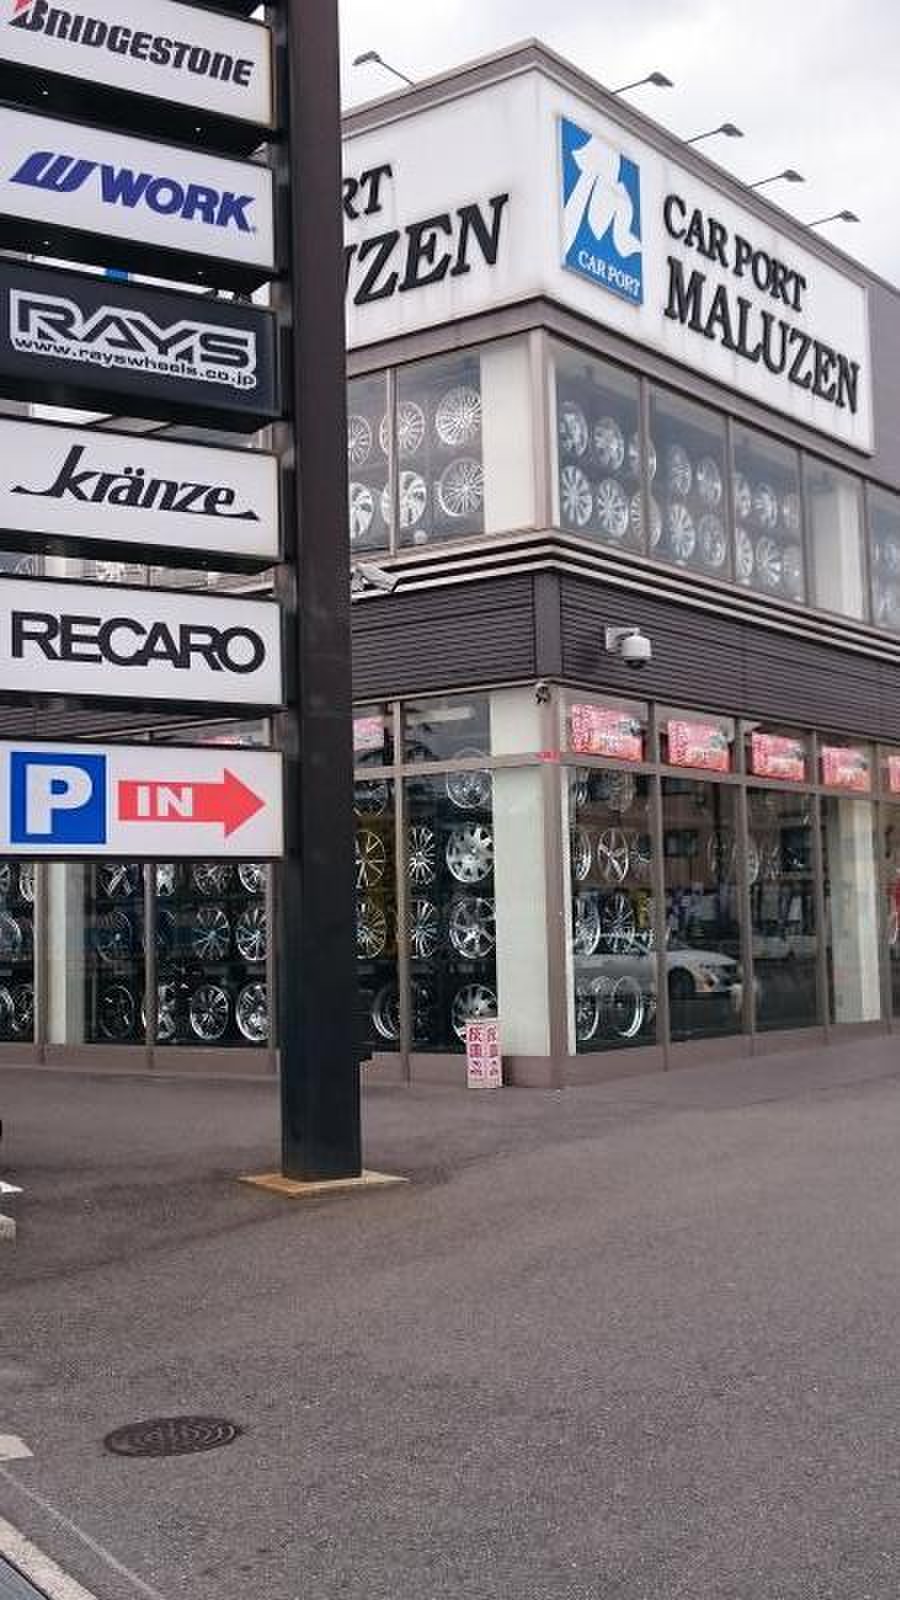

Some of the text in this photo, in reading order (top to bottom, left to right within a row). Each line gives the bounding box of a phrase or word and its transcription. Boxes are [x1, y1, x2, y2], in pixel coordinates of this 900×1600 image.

[8, 0, 254, 86] BRIDGESTONE
[100, 164, 256, 233] WORK
[344, 193, 509, 306] ZEN
[578, 250, 641, 297] CAR PORT
[663, 194, 807, 312] CAR PORT
[10, 289, 256, 370] RAYS
[14, 337, 256, 390] www.rayswheels.co.jp
[664, 255, 860, 414] MALUZEN
[10, 445, 259, 521] kränze
[11, 611, 265, 674] RECARO
[25, 764, 193, 835] P IN
